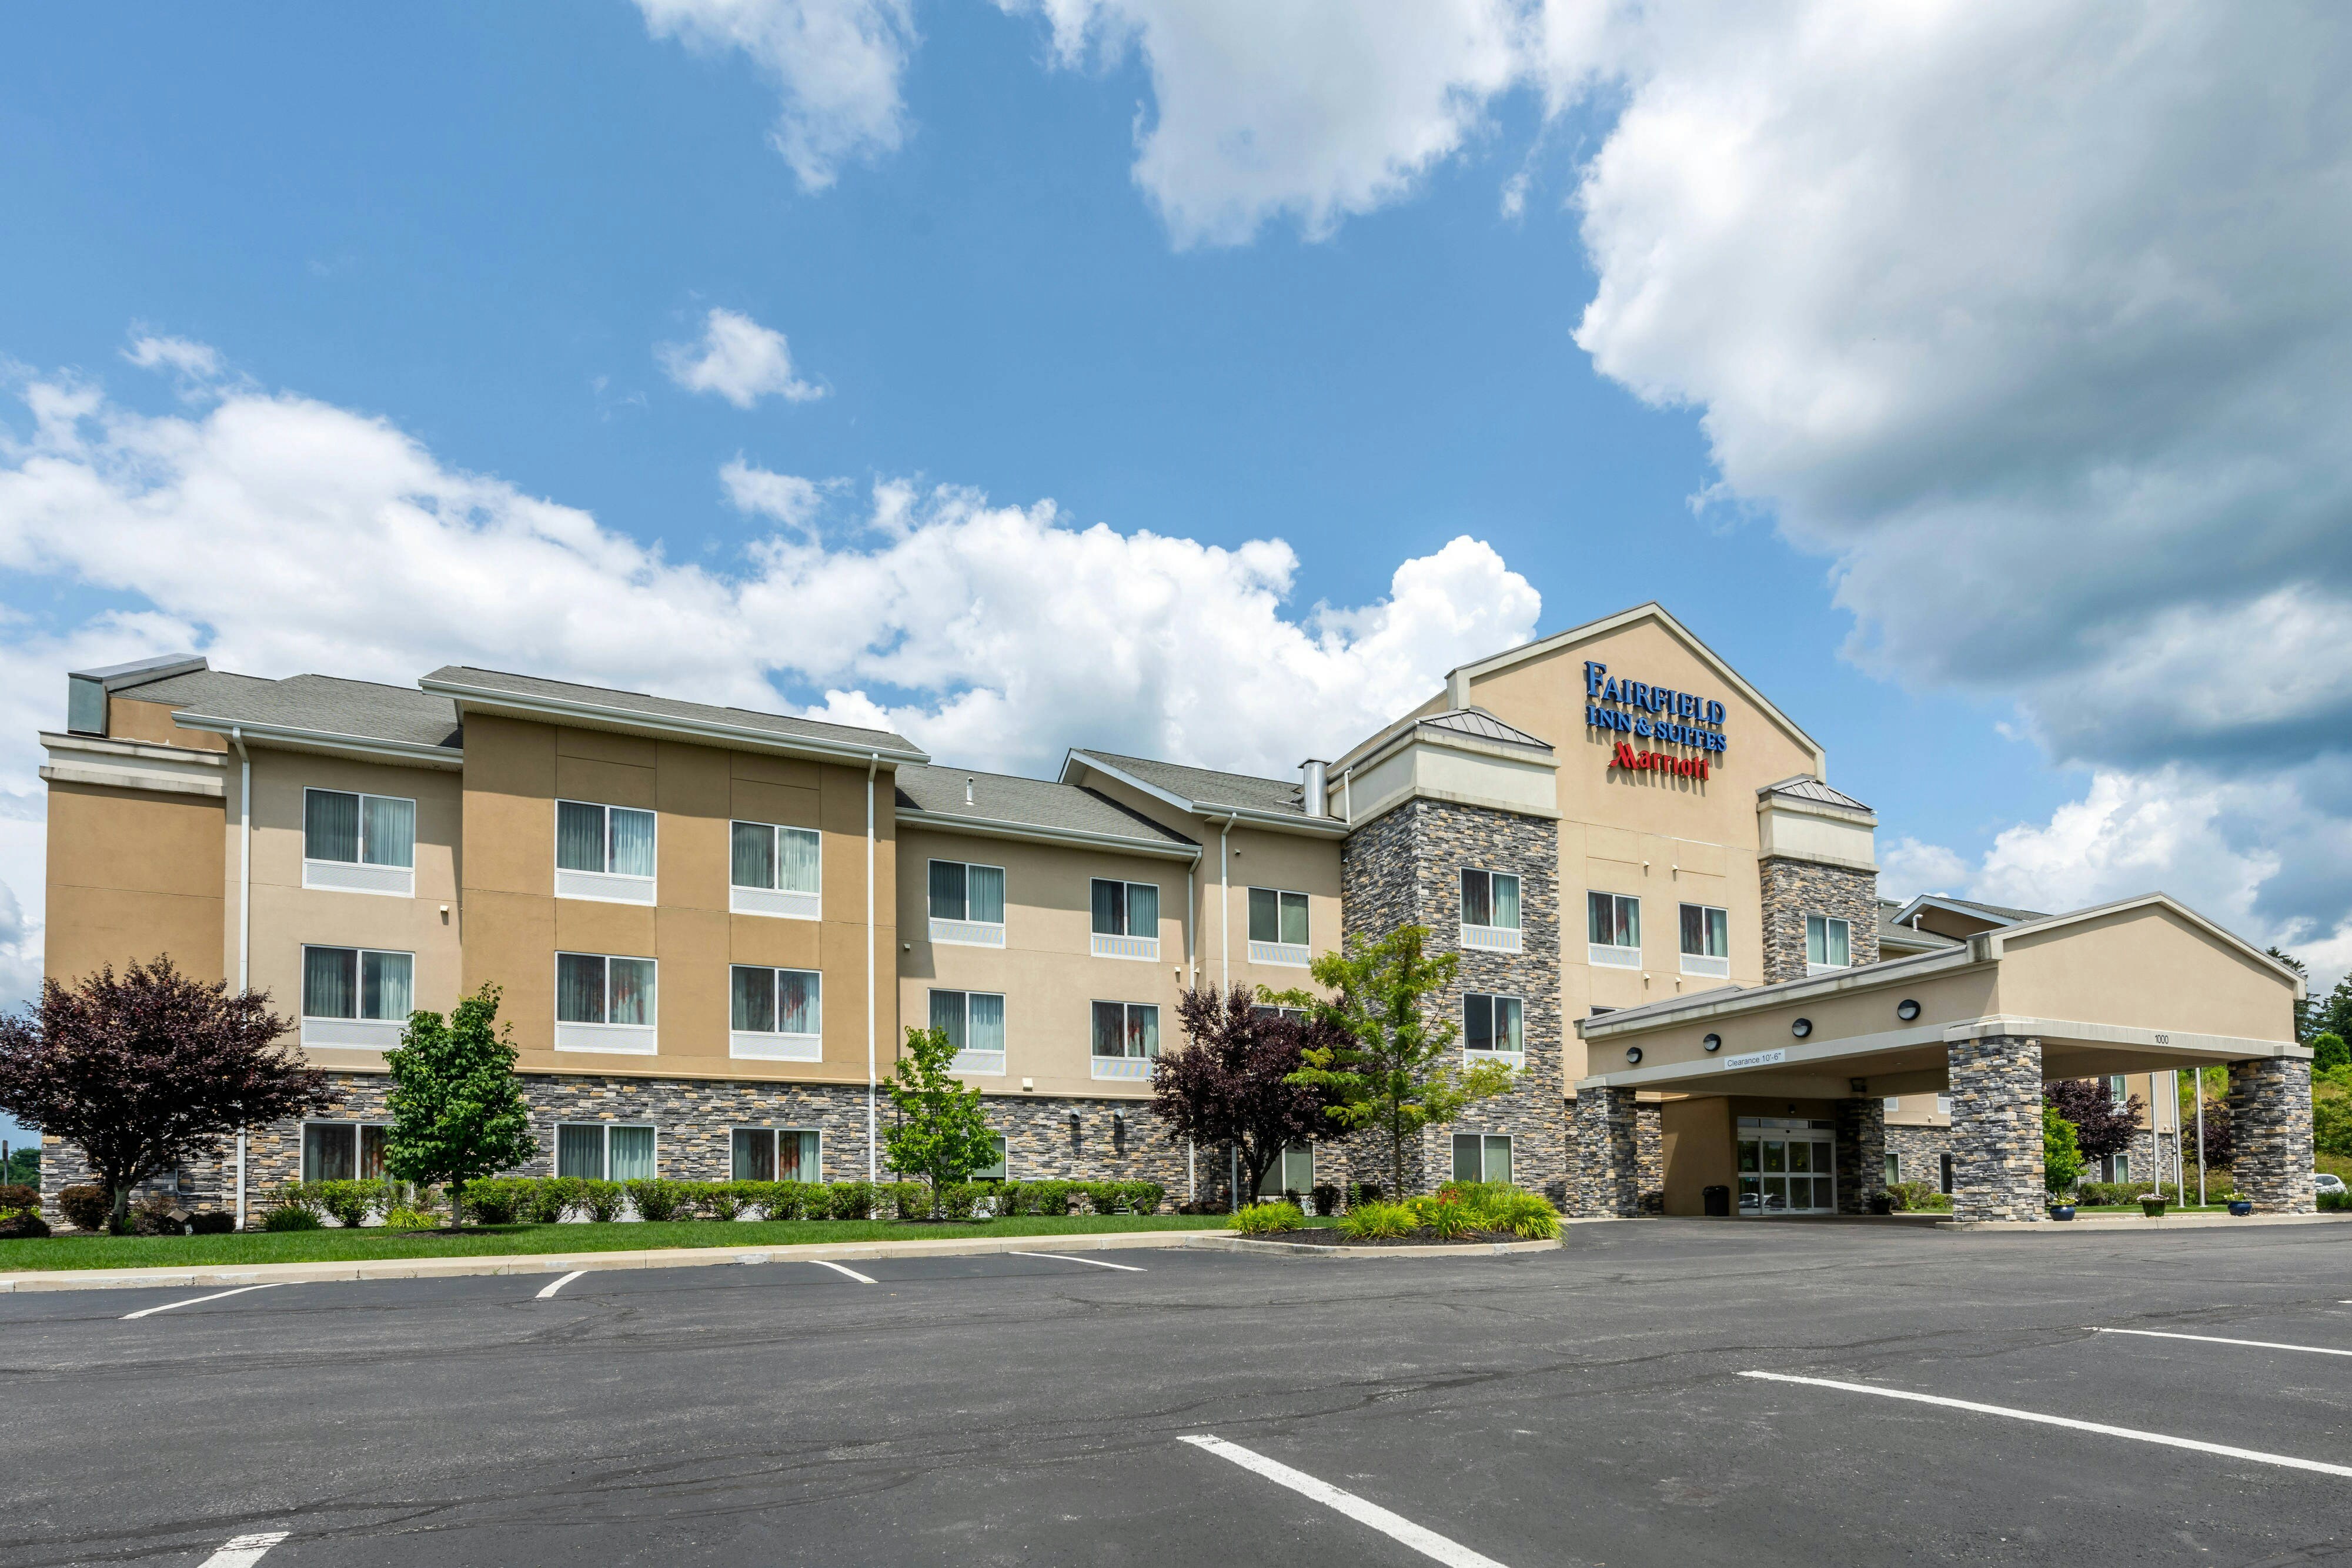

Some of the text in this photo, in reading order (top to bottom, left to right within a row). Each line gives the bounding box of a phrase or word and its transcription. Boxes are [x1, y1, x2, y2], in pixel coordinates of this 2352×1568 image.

[1584, 661, 1726, 724] FAIRFIELD
[1586, 705, 1727, 752] INN & SUITES
[1608, 741, 1709, 780] Marriott
[2154, 1034, 2169, 1045] 1000
[1728, 1057, 1759, 1067] Clearance
